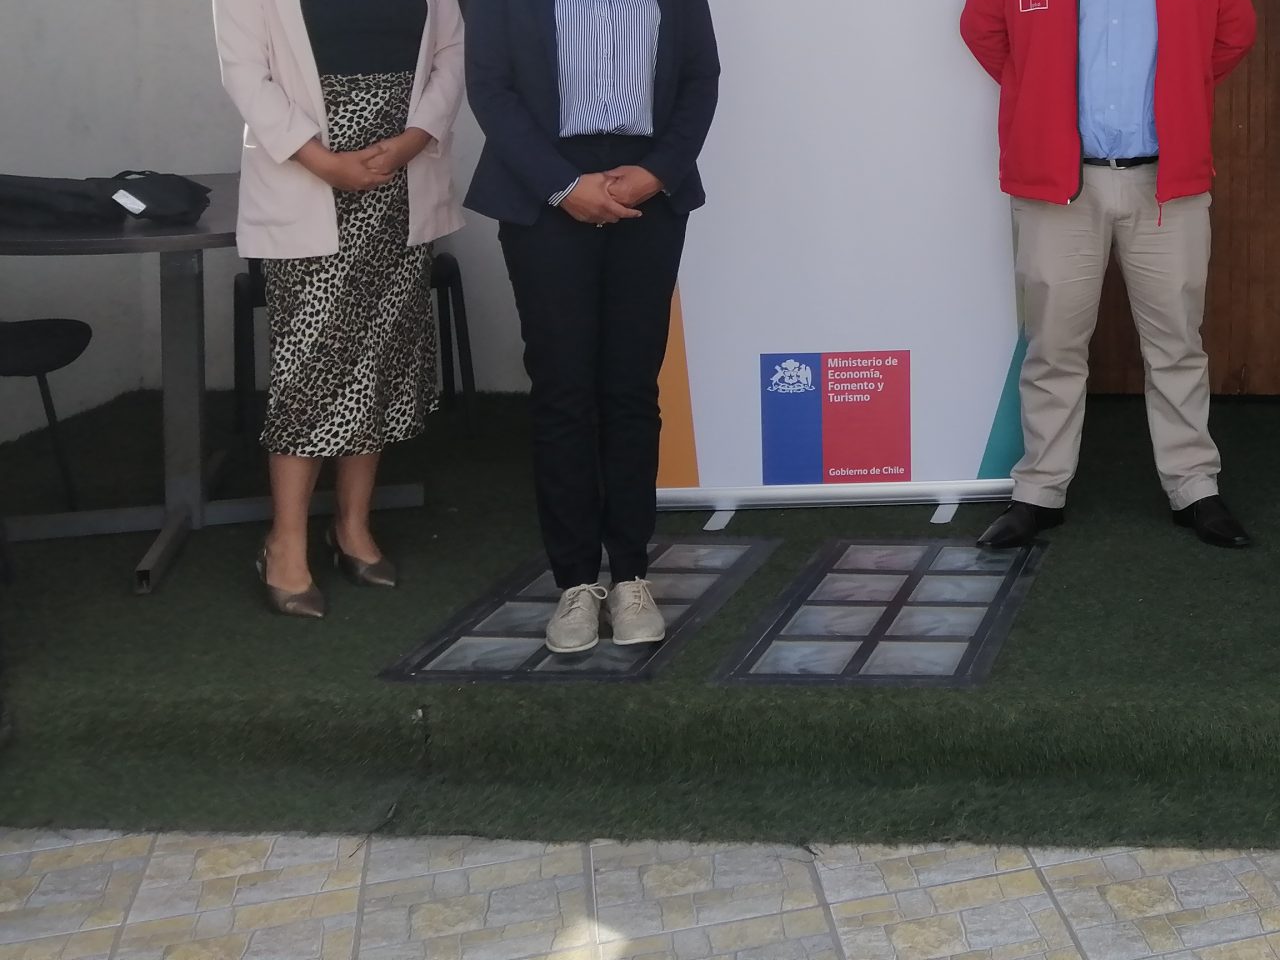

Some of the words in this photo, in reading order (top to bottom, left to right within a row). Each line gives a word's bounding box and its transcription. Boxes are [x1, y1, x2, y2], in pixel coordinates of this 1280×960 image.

[827, 356, 883, 367] Ministerio
[885, 356, 898, 366] de
[827, 368, 883, 379] Economía,
[828, 381, 875, 392] Fomento
[877, 382, 885, 392] y
[828, 392, 871, 403] Turismo
[828, 467, 868, 476] Gobierno
[869, 466, 881, 475] de
[882, 466, 905, 475] Chile
